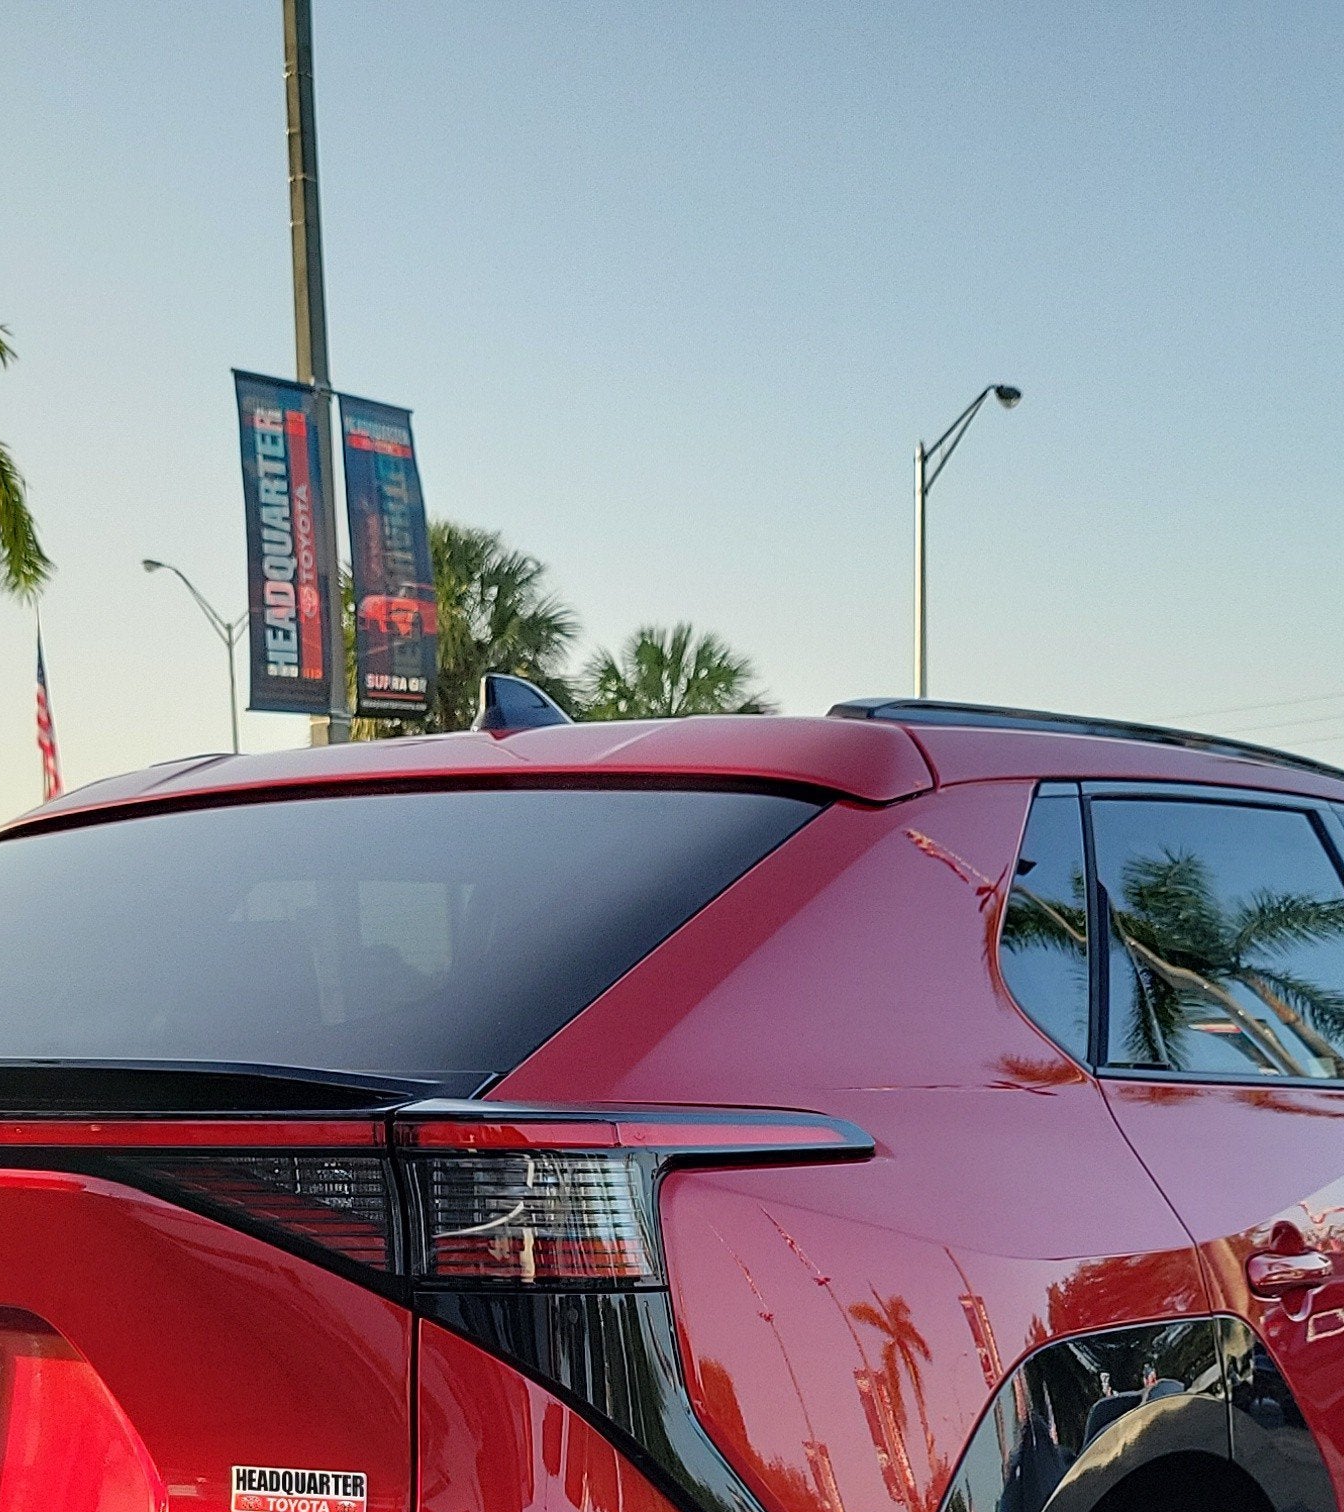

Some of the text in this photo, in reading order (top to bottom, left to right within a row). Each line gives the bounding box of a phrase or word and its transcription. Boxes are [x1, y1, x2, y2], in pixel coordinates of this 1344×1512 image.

[253, 409, 299, 678] HEADQUARTER
[294, 484, 316, 585] TOYOTA
[236, 1468, 365, 1497] HEADQUARTER
